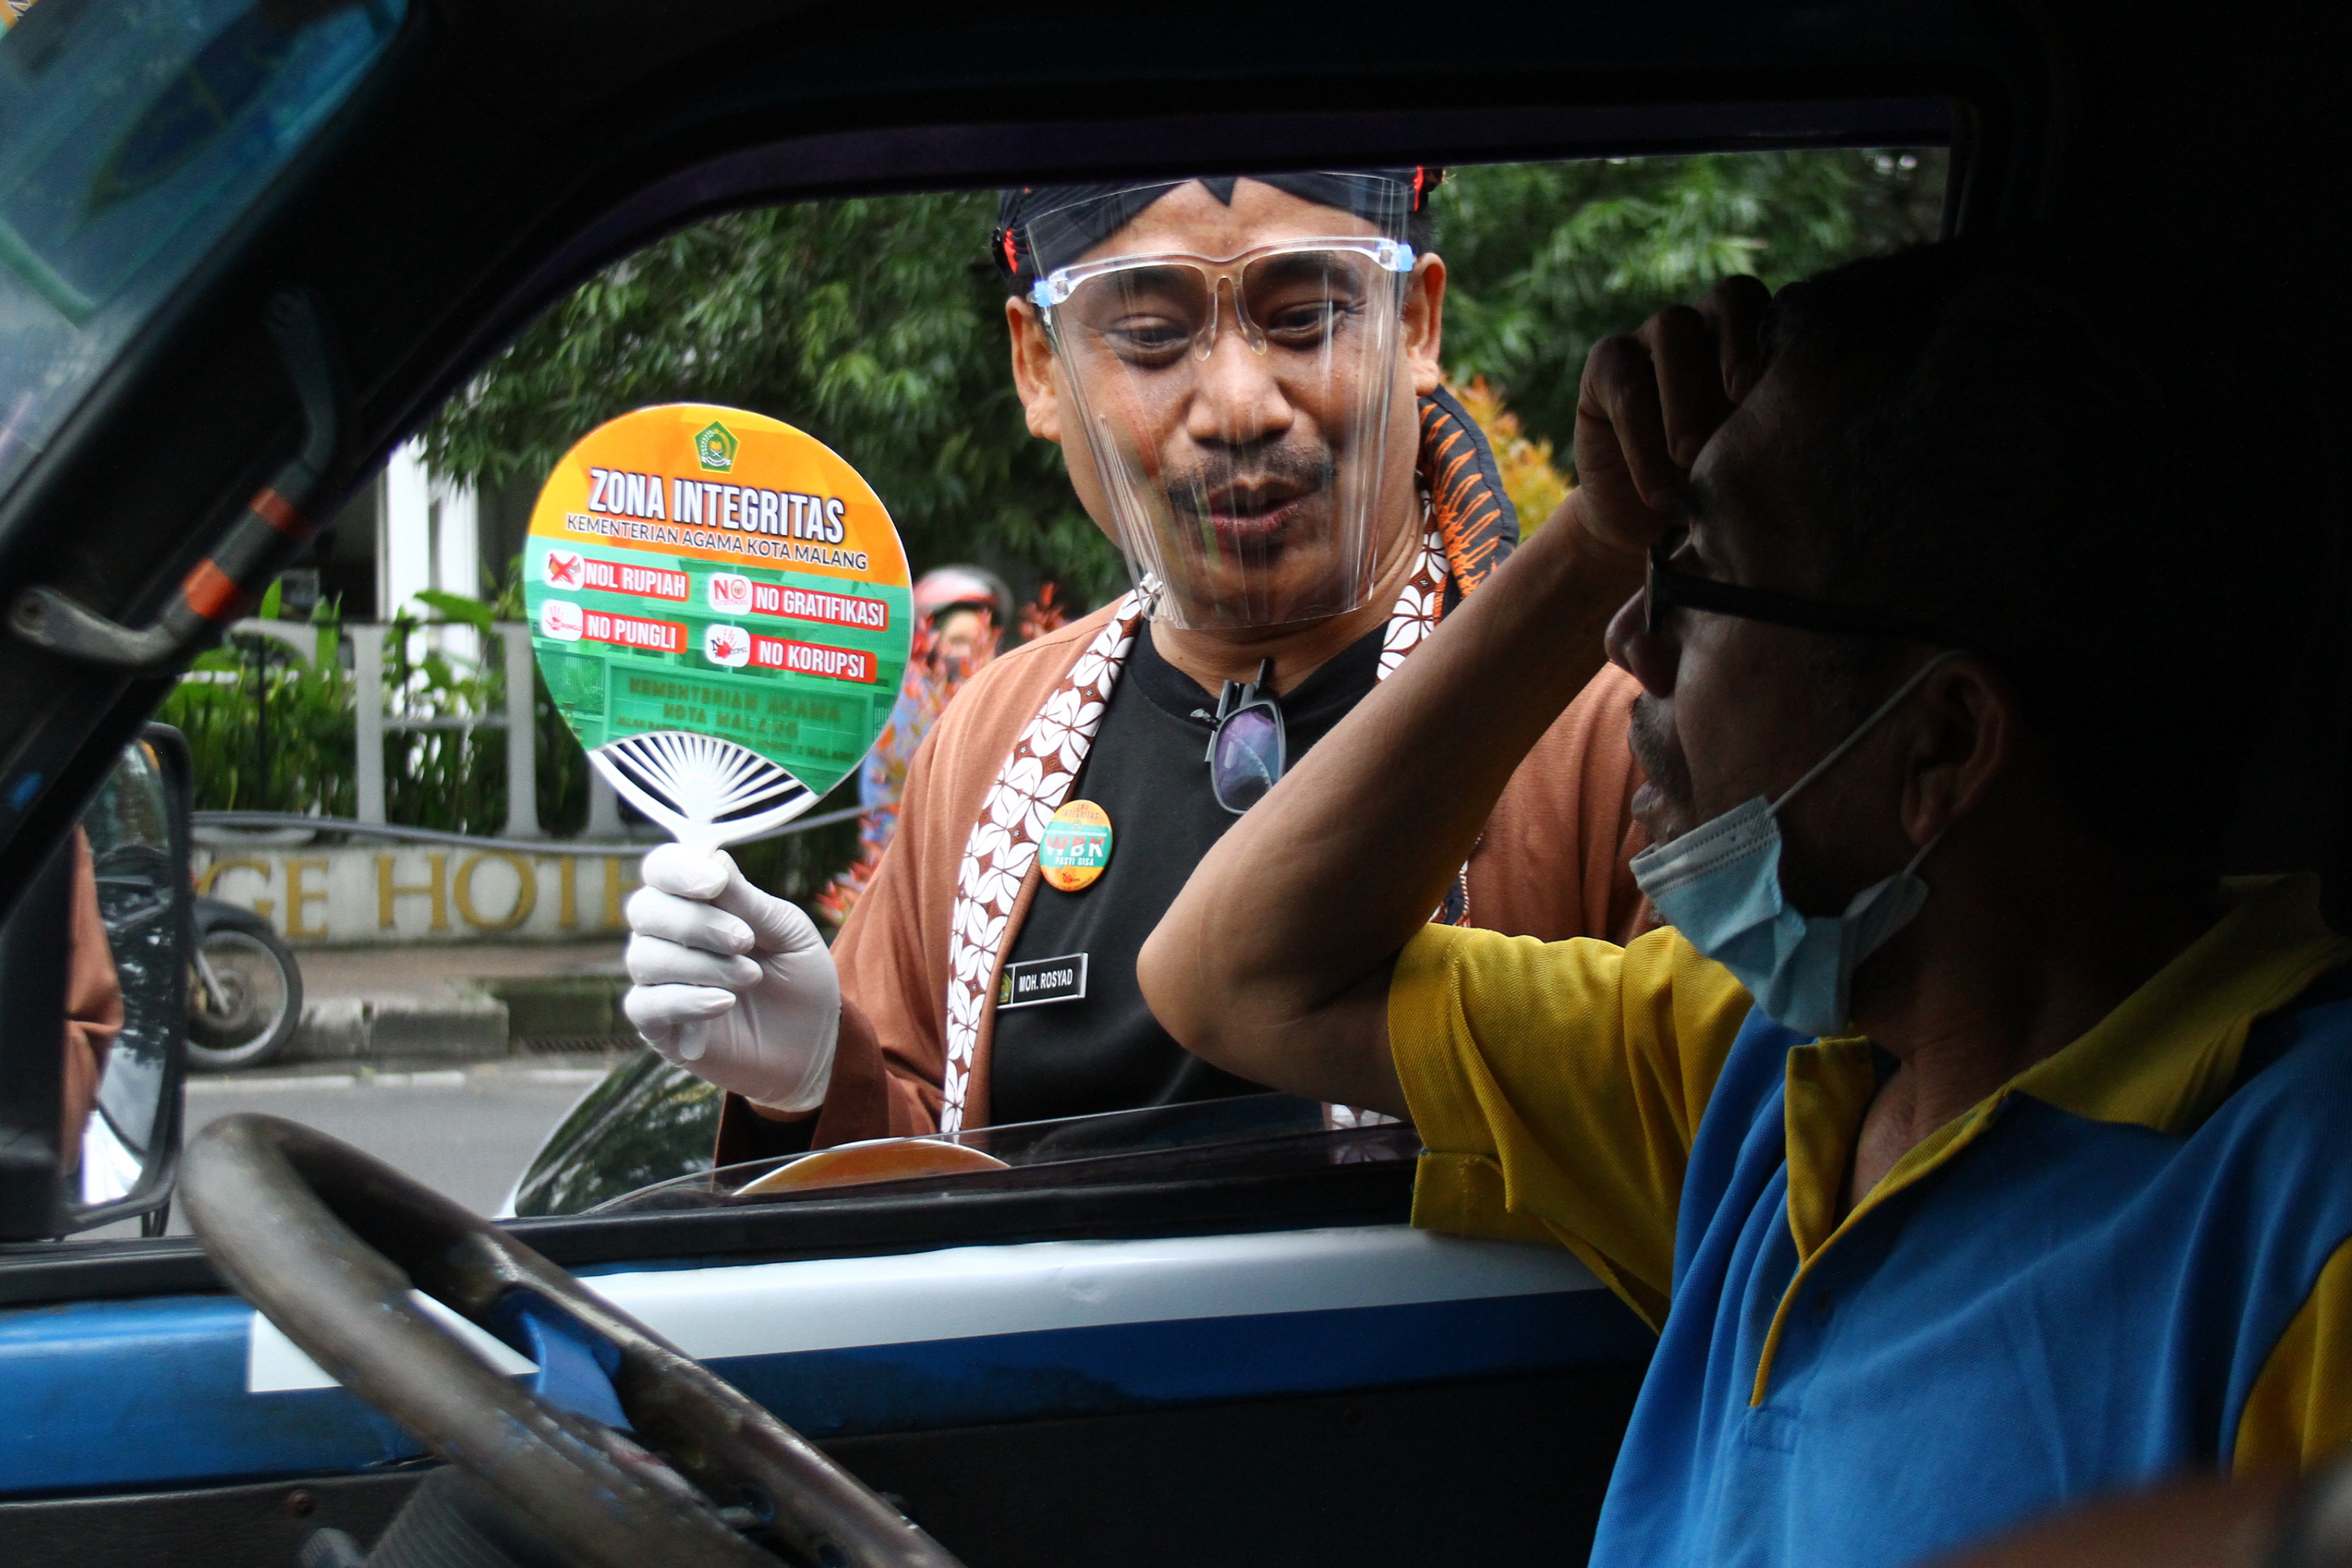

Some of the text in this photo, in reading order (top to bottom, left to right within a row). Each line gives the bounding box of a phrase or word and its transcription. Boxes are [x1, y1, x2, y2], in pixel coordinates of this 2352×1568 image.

[589, 468, 845, 544] ZONA INTEGRITAS
[568, 514, 868, 570] KEMENTERIAN AGAMA KOTA MALANG
[585, 563, 686, 598] NOL RUPIAH
[756, 585, 885, 627] NO GRATIFIKASI
[587, 615, 676, 649] NO PUNGLI
[759, 640, 866, 679] NO KORUPSI
[664, 703, 707, 724] KOTA
[1046, 836, 1107, 858] WBK
[1056, 856, 1094, 866] PASTI BISA
[1019, 968, 1073, 992] MOH. ROSYAD
